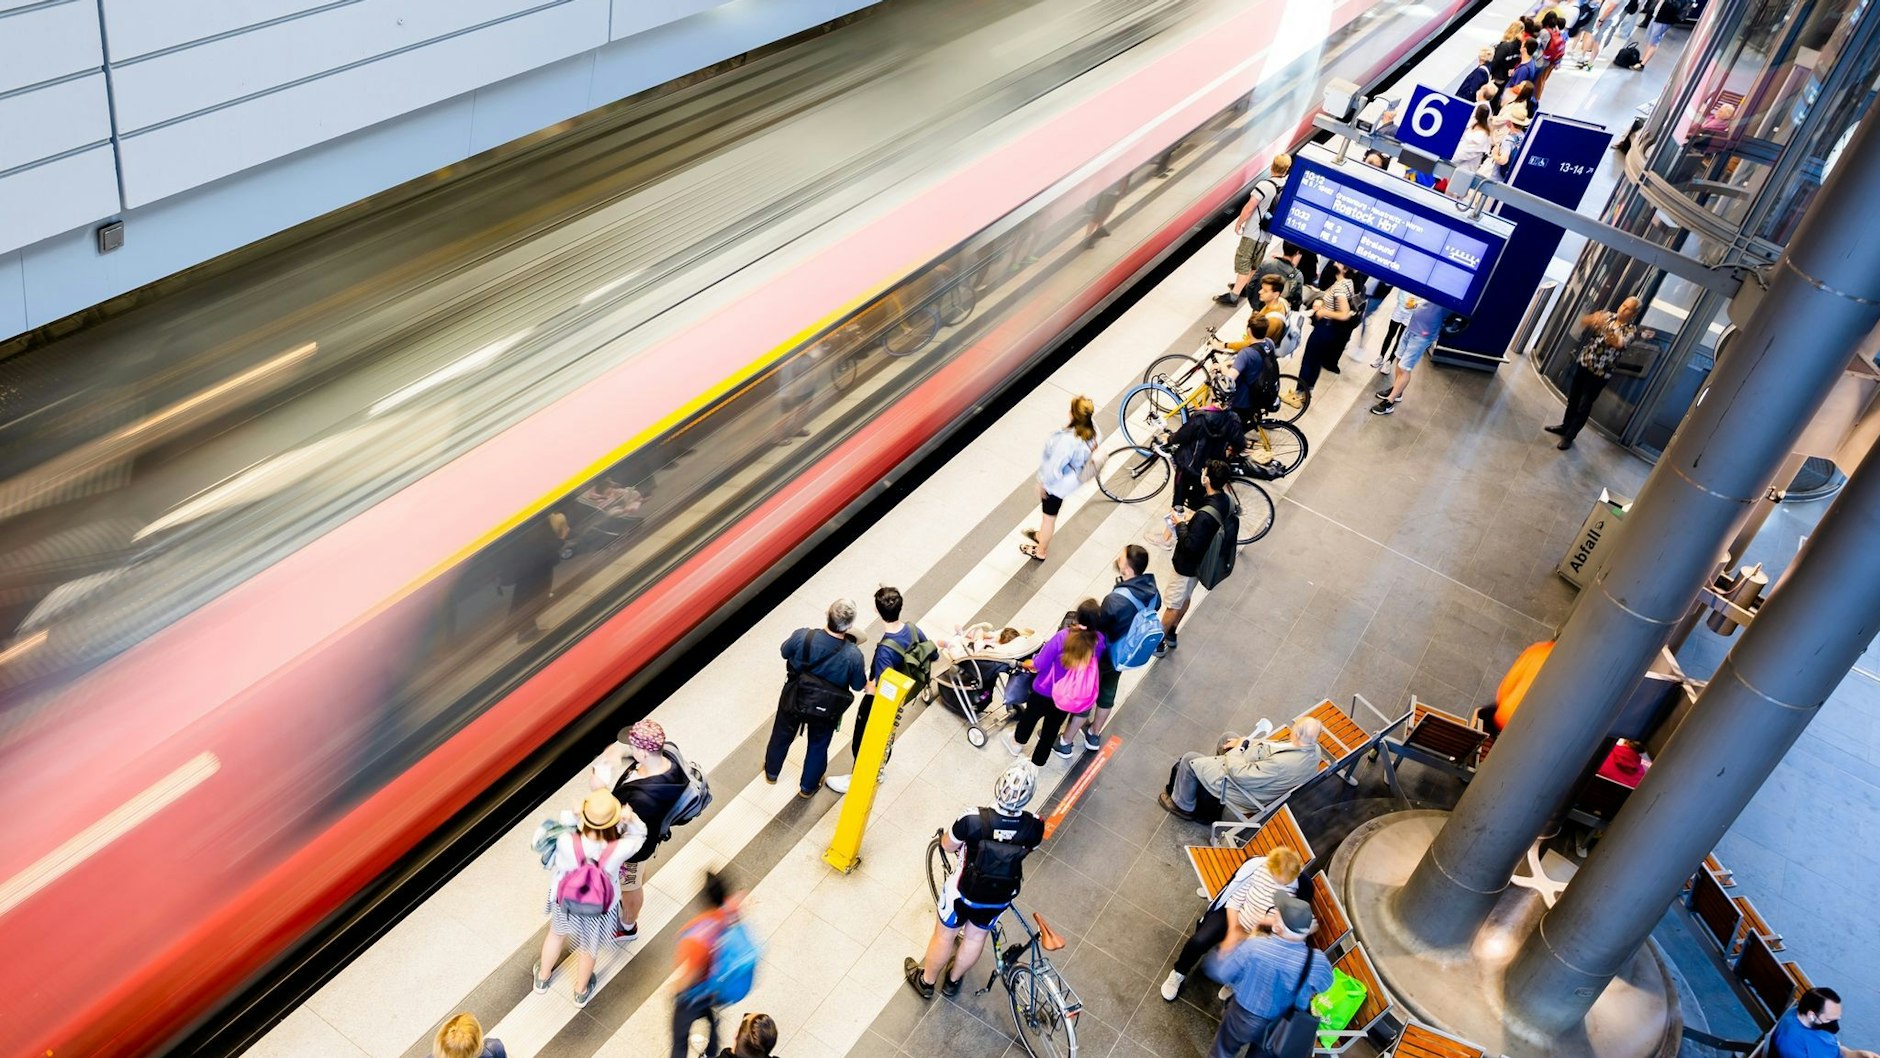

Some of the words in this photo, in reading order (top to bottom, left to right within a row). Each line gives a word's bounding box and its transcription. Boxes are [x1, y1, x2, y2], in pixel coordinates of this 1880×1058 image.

[1411, 92, 1450, 138] 6
[1304, 169, 1326, 185] 10:12
[1559, 162, 1585, 175] 13-14
[1332, 200, 1375, 225] Rostock
[1376, 217, 1398, 233] Hbf
[1570, 529, 1601, 573] Abfall
